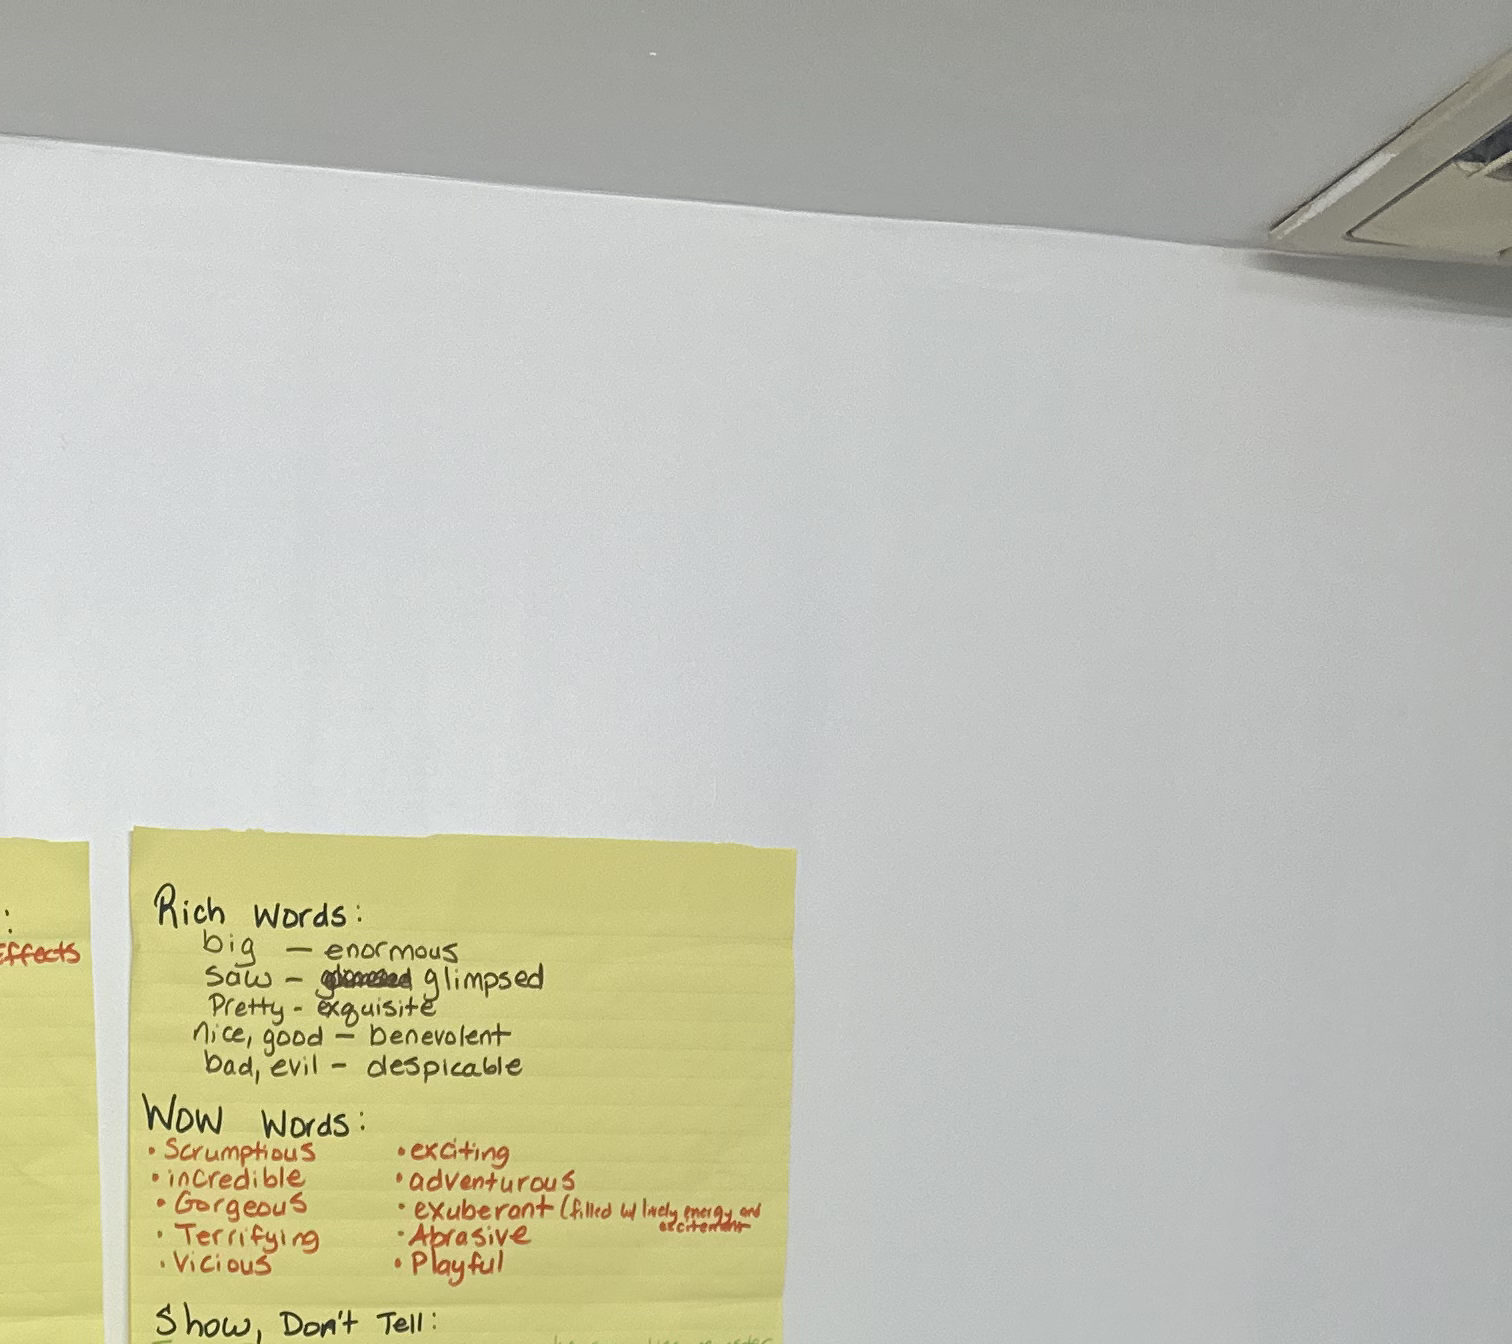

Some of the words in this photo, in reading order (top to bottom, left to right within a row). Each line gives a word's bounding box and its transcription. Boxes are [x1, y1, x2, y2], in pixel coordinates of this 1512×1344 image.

[153, 882, 226, 930] Rich
[202, 929, 256, 968] big
[324, 941, 458, 964] enormous
[422, 958, 545, 1003] glimpsed
[208, 993, 284, 1026] Pretty
[316, 995, 439, 1028] exquisite
[193, 1021, 252, 1049] nice,
[263, 1026, 324, 1057] good
[369, 1022, 512, 1048] benevolent
[204, 1049, 260, 1085] bad,
[270, 1053, 317, 1077] evil
[366, 1054, 523, 1084] despicable
[410, 1141, 510, 1169] exciting
[409, 1168, 575, 1193] adventurous
[175, 1190, 307, 1223] Gorgeous
[414, 1194, 554, 1222] exuberant
[174, 1222, 320, 1258] Terrifying
[408, 1223, 532, 1250] Abrasive
[173, 1249, 275, 1276] Vicious
[411, 1247, 503, 1287] Playful
[278, 1310, 358, 1338] Don't
